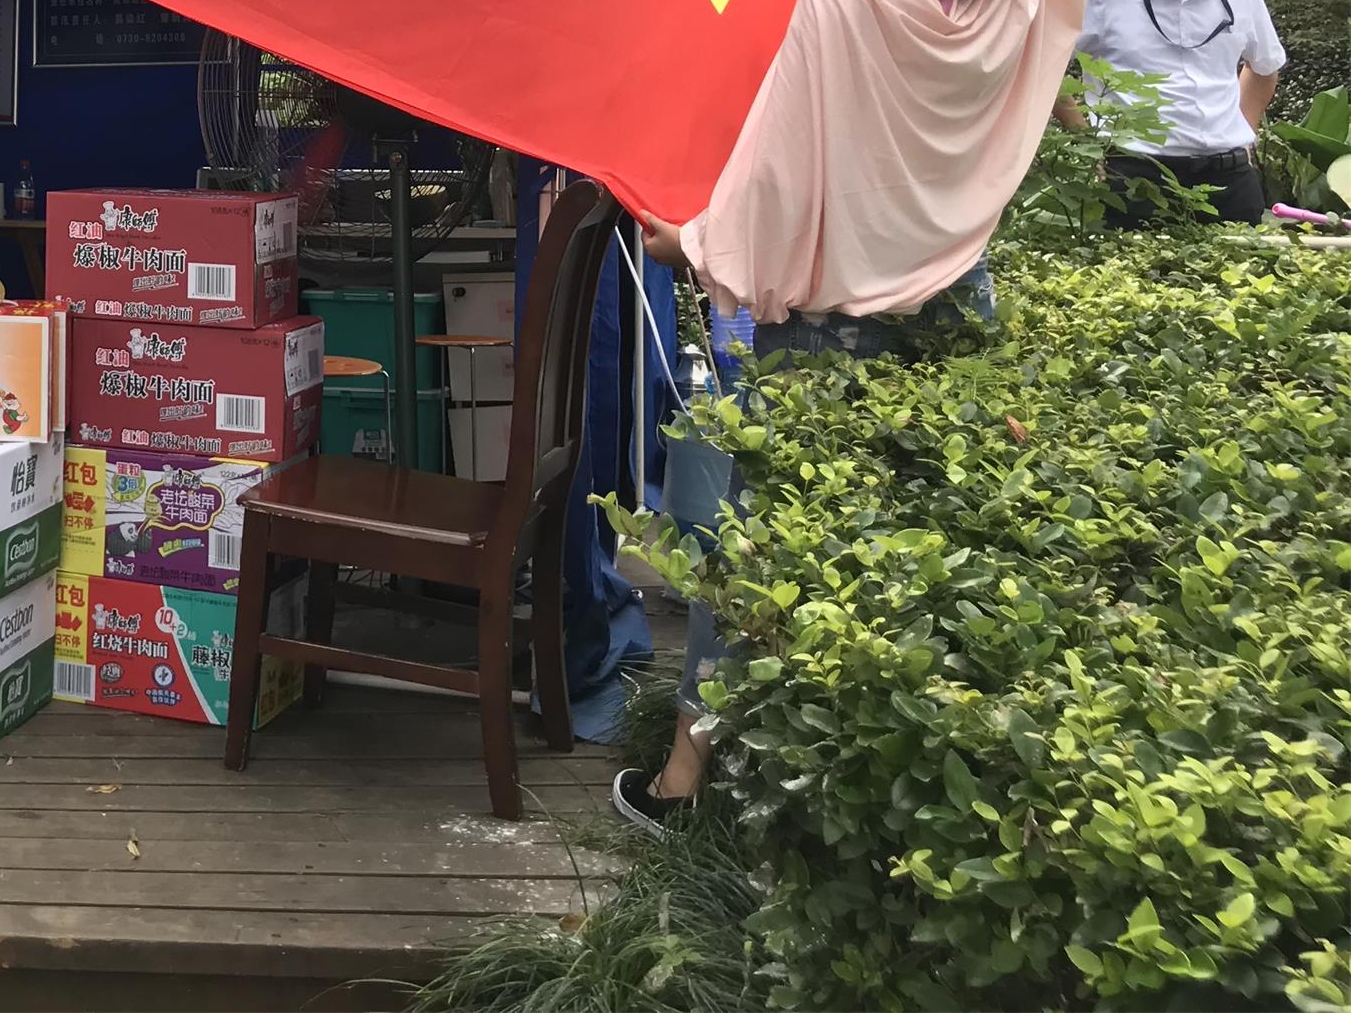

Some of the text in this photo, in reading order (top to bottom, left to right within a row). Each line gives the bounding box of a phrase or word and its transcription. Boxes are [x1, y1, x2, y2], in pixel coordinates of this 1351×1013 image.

[69, 221, 103, 240] 红油
[73, 243, 186, 273] 爆椒牛肉面
[94, 300, 122, 316] 红油
[123, 300, 193, 322] 爆椒牛肉面
[95, 348, 130, 367] 红油
[100, 370, 215, 403] 爆椒牛肉面
[121, 429, 149, 446] 红油
[150, 430, 222, 453] 爆椒牛肉面
[160, 489, 215, 510] 老坛酸菜
[165, 506, 208, 524] 牛肉面
[93, 632, 169, 659] 红烧牛肉面
[192, 645, 231, 669] 藤椒
